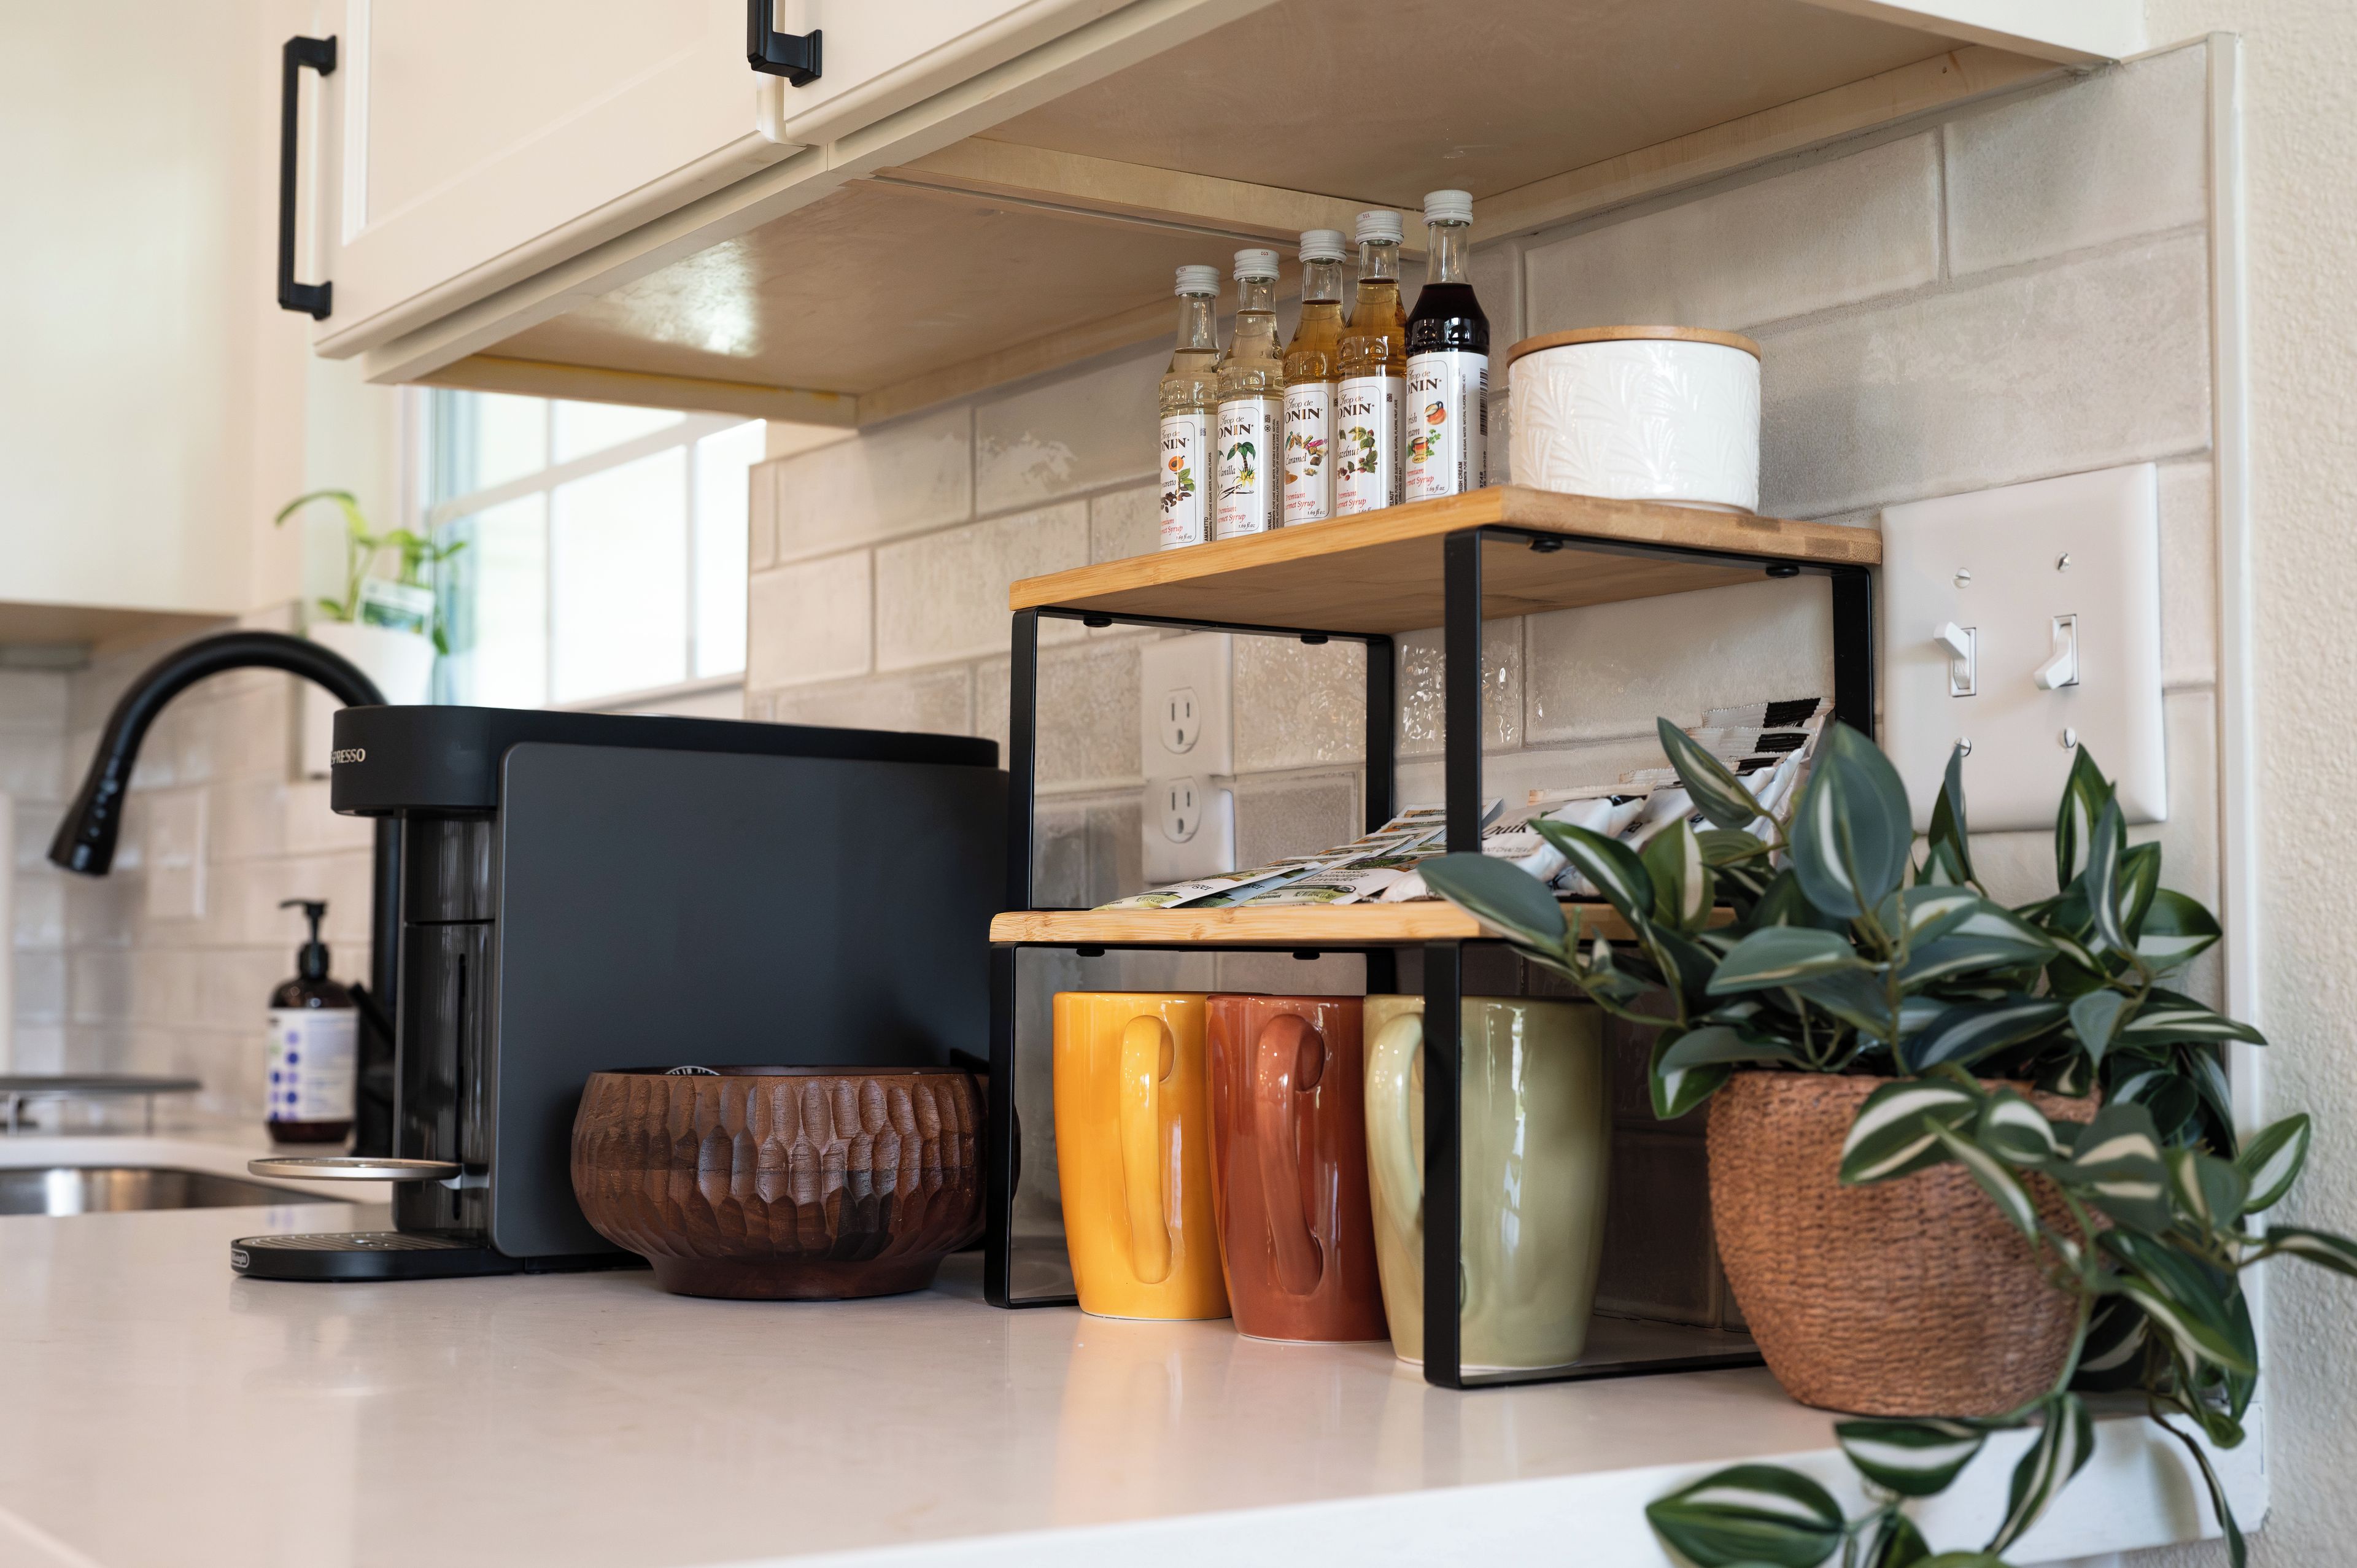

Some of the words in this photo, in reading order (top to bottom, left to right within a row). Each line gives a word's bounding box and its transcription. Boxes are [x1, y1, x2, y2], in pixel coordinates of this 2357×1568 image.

[1407, 428, 1420, 438] ream
[1416, 476, 1434, 487] Syrup
[1434, 484, 1439, 493] fl
[1298, 501, 1315, 511] Syrup
[1349, 498, 1366, 509] Syrup
[1229, 513, 1245, 524] Syrup
[1167, 525, 1183, 536] Syrup
